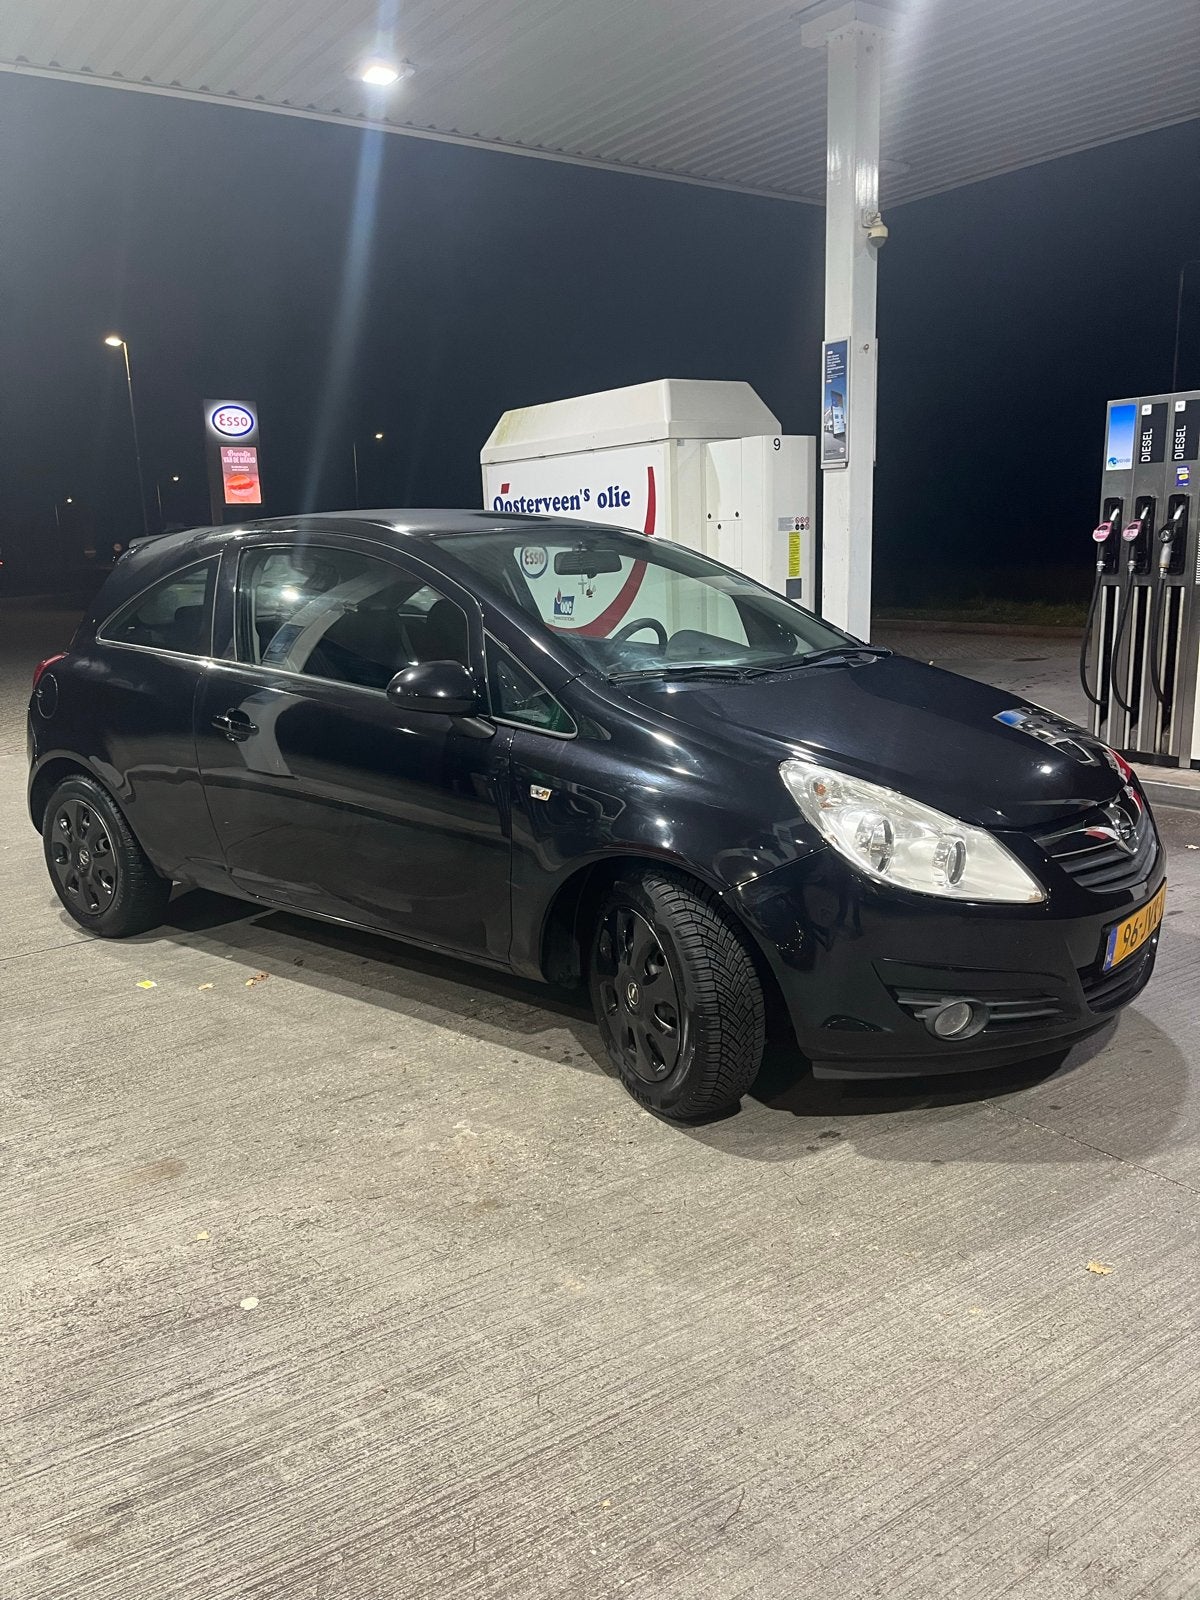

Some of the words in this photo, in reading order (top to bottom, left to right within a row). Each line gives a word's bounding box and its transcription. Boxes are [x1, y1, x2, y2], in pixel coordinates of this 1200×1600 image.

[773, 437, 781, 451] 9
[1141, 428, 1153, 462] DIESEL
[1174, 425, 1187, 460] DIESEL
[493, 488, 591, 513] Oosterveen's
[597, 485, 631, 508] olie
